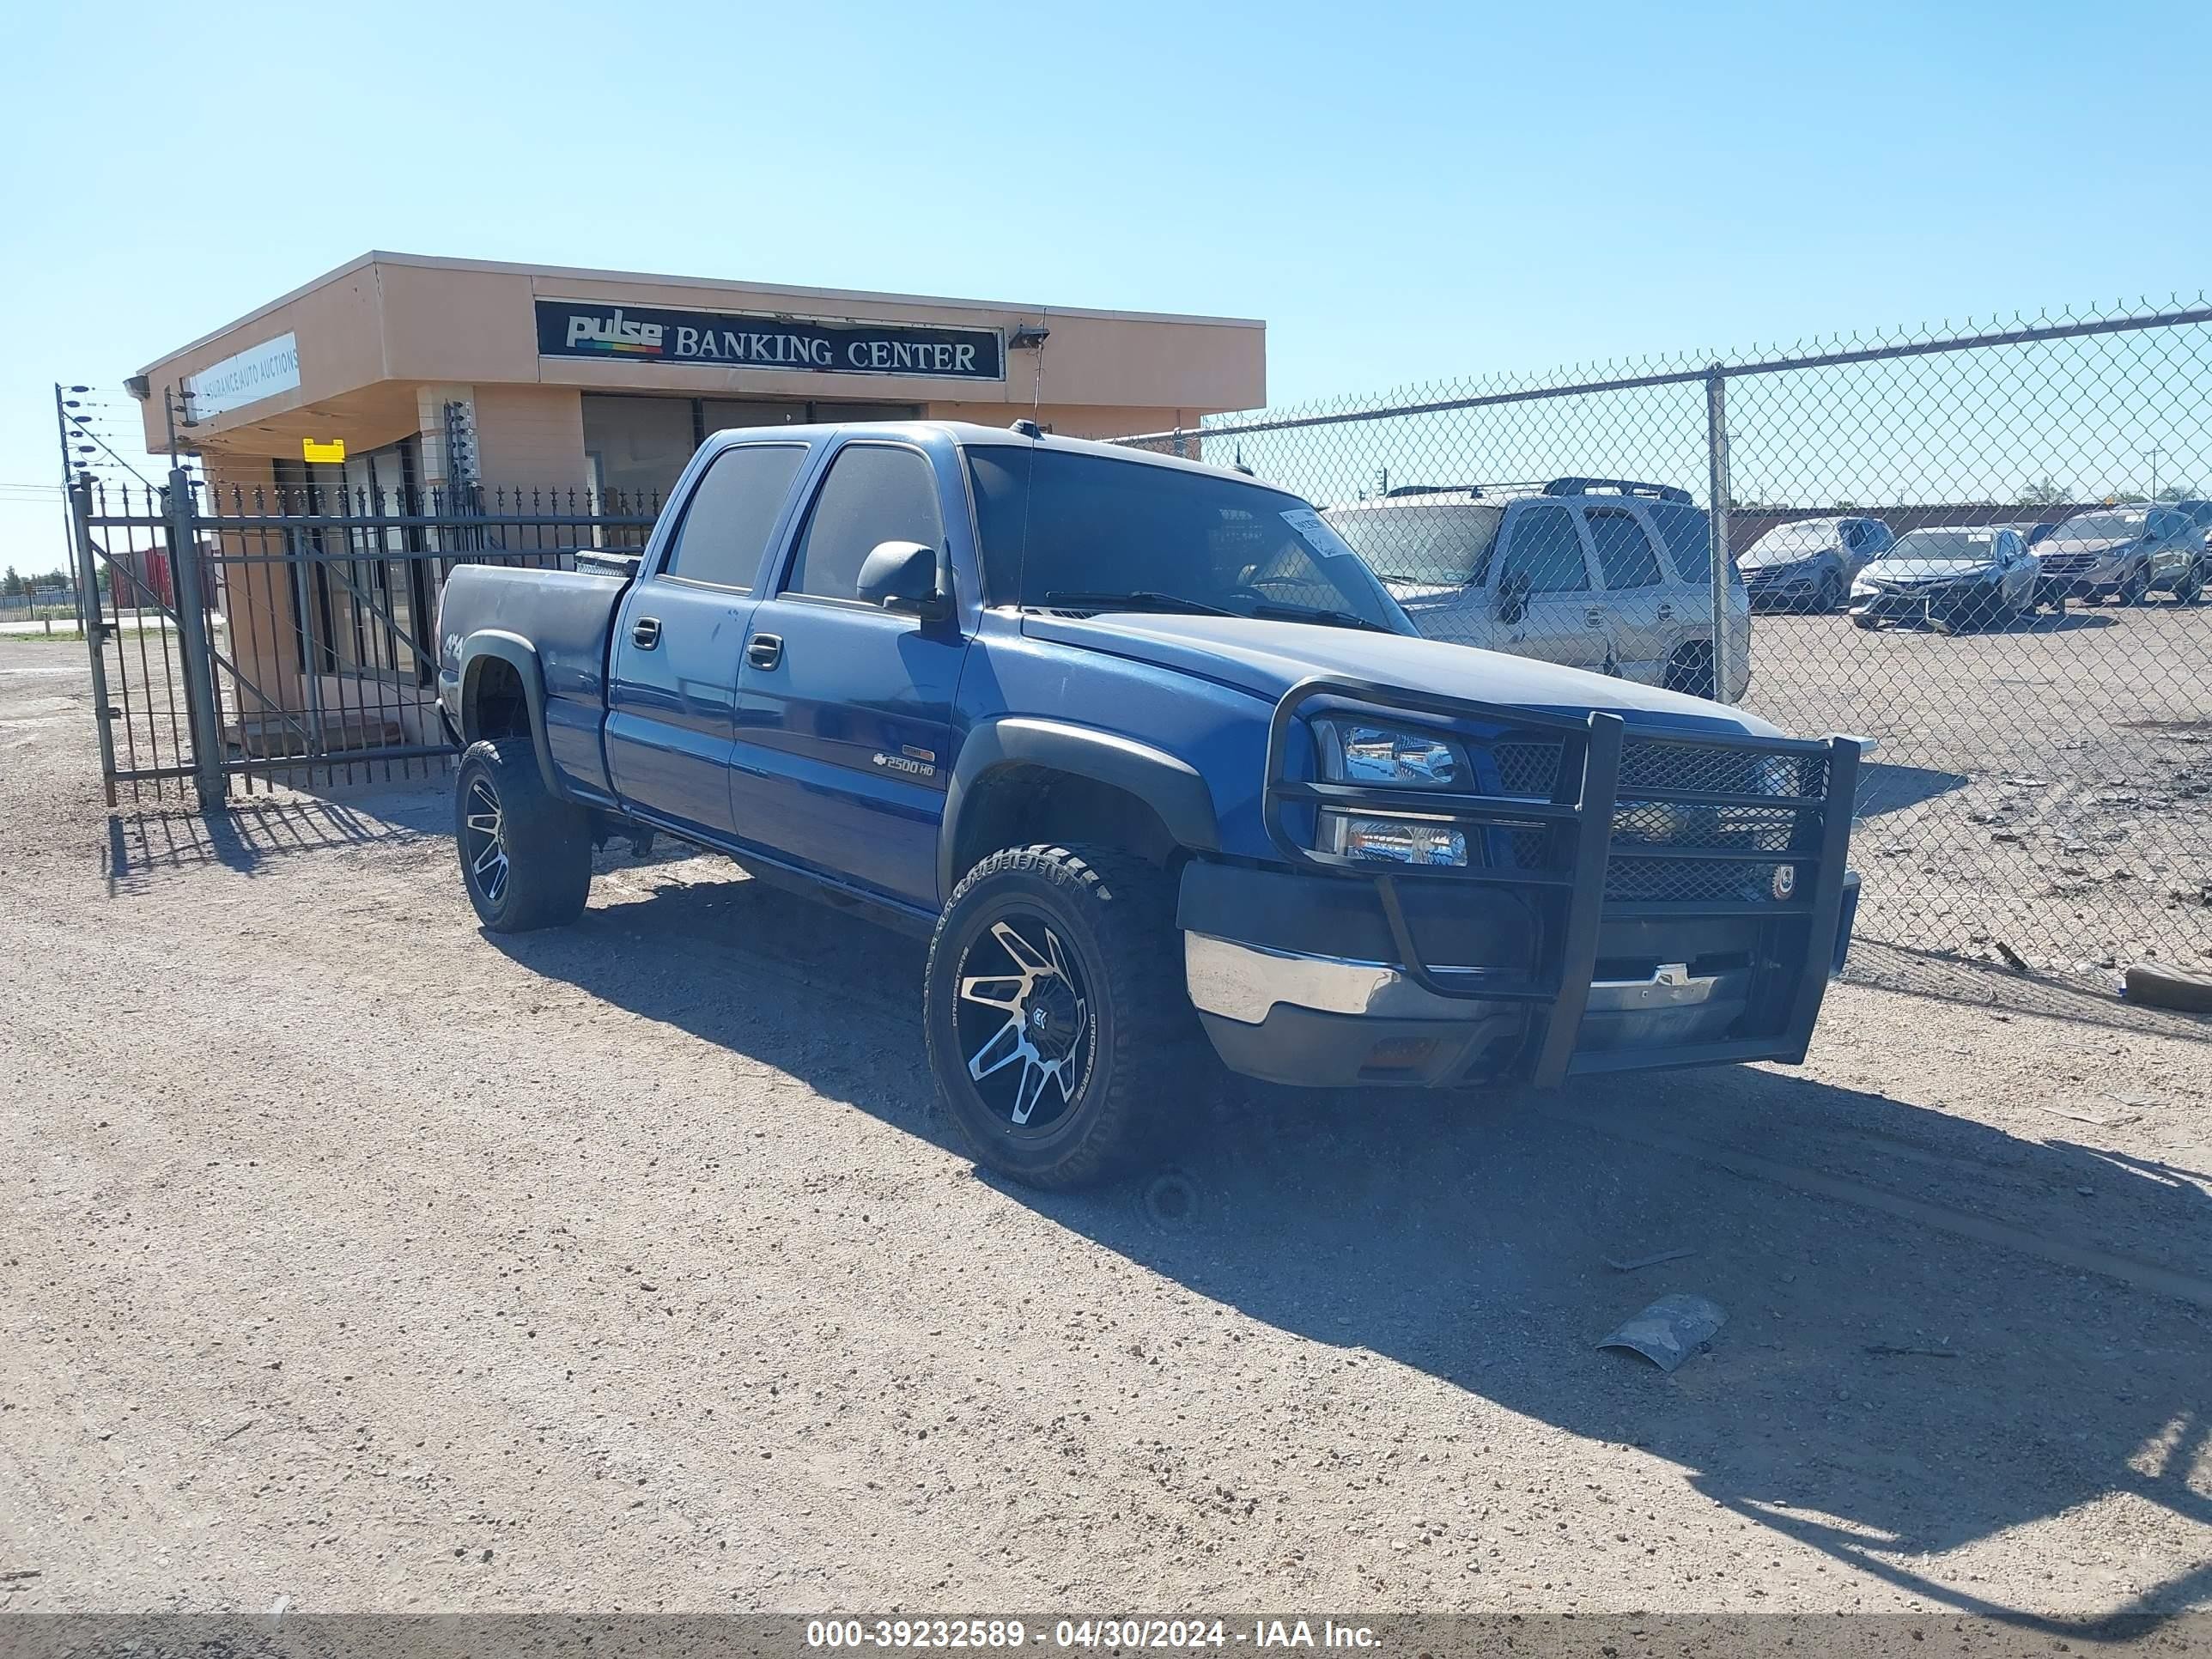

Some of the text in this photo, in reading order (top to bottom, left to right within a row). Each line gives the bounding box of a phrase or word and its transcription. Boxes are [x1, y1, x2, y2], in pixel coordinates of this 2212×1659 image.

[567, 309, 976, 372] pulse BANKING CENTER
[240, 364, 258, 390] AUTO
[260, 349, 299, 381] AUCTIONS
[887, 757, 918, 774] 2500
[1077, 1013, 1097, 1102] DROPSTARS
